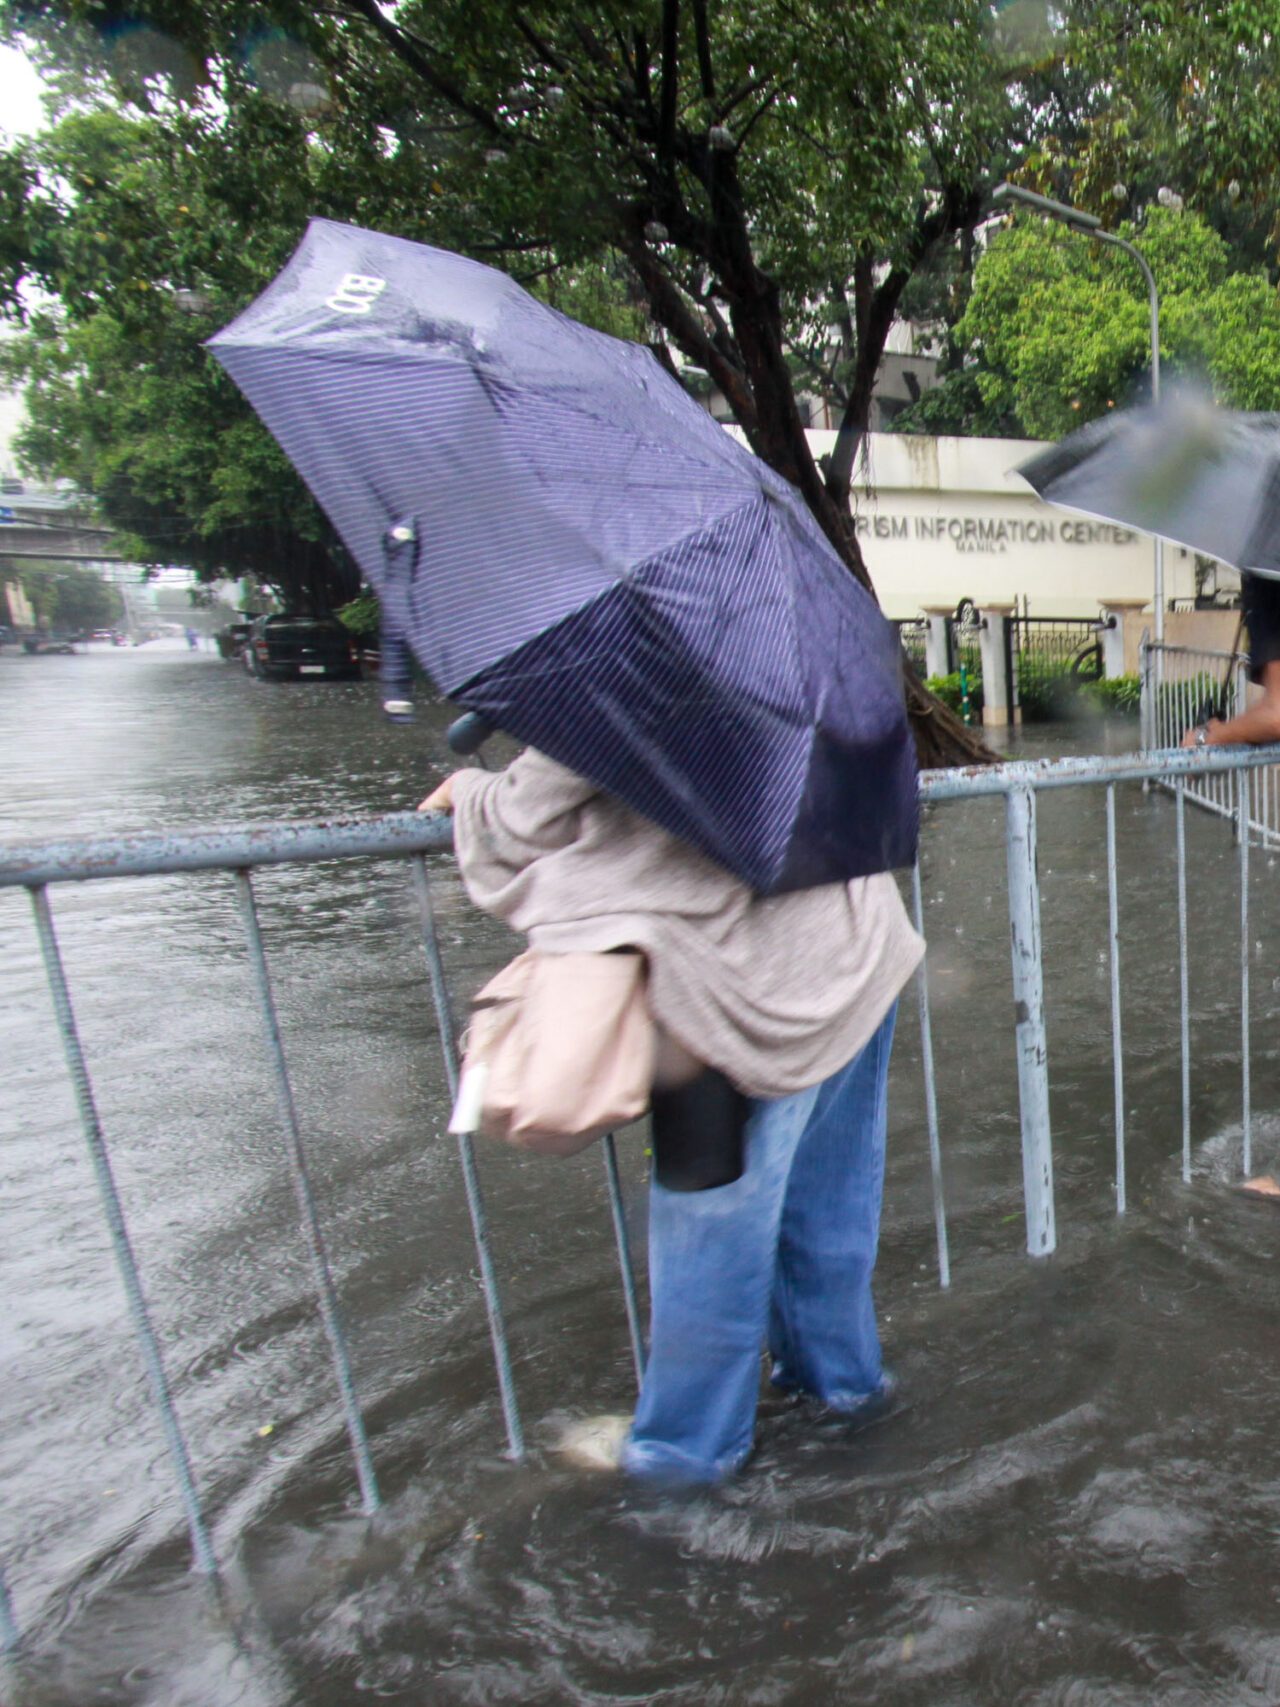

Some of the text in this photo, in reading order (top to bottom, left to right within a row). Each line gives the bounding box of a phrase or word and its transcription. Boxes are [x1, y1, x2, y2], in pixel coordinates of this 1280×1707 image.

[325, 272, 386, 314] BDO
[855, 515, 1139, 545] RISM INFORMATION CENTER
